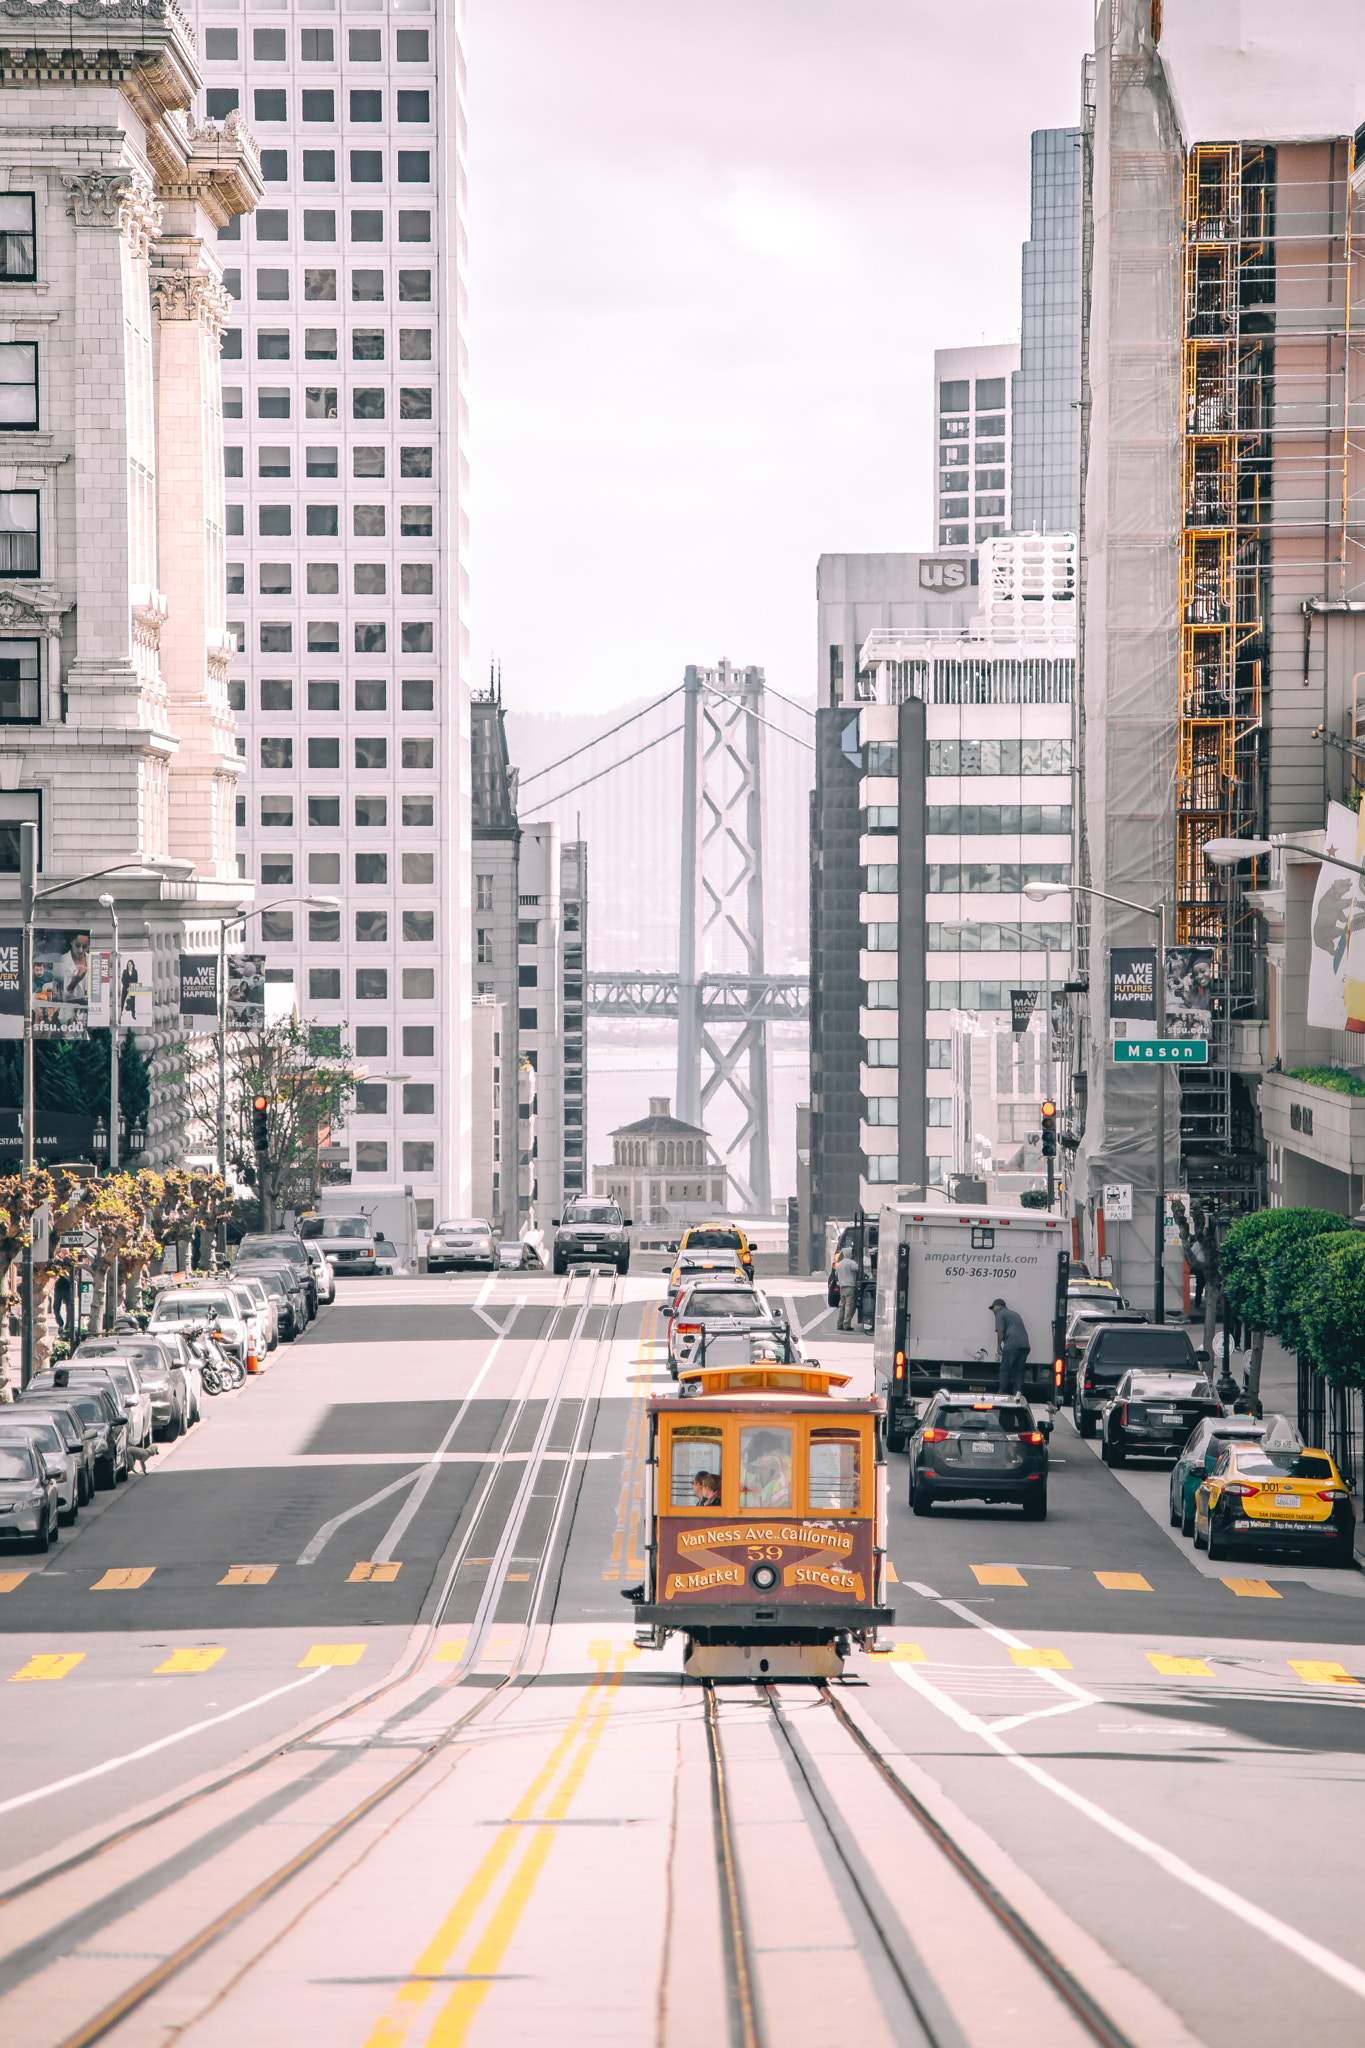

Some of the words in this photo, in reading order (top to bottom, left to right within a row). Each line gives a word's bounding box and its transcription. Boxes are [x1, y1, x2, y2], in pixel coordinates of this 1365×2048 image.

[0, 960, 19, 972] KE
[1131, 963, 1152, 974] WE
[197, 967, 215, 976] WE
[92, 960, 100, 995] CENTURY
[183, 976, 215, 985] MAKE
[1114, 974, 1152, 984] MAKE
[1114, 993, 1152, 1001] HAPPEN
[33, 1021, 84, 1031] sfsu.edu
[228, 1020, 262, 1028] sfsu.edu
[1168, 1026, 1210, 1034] sfsu.edu
[1128, 1045, 1192, 1057] Mason
[901, 1248, 906, 1256] 3
[924, 1252, 1038, 1264] ampartyrentals.com
[1062, 1255, 1067, 1263] 3
[945, 1267, 1016, 1278] 650-363-1050
[1261, 1483, 1279, 1492] 1001
[680, 1534, 705, 1547] Van
[707, 1529, 741, 1543] Ness
[781, 1527, 850, 1549] California
[747, 1546, 783, 1561] 59
[674, 1576, 684, 1588] &
[688, 1568, 738, 1586] Market
[796, 1568, 854, 1587] Streets
